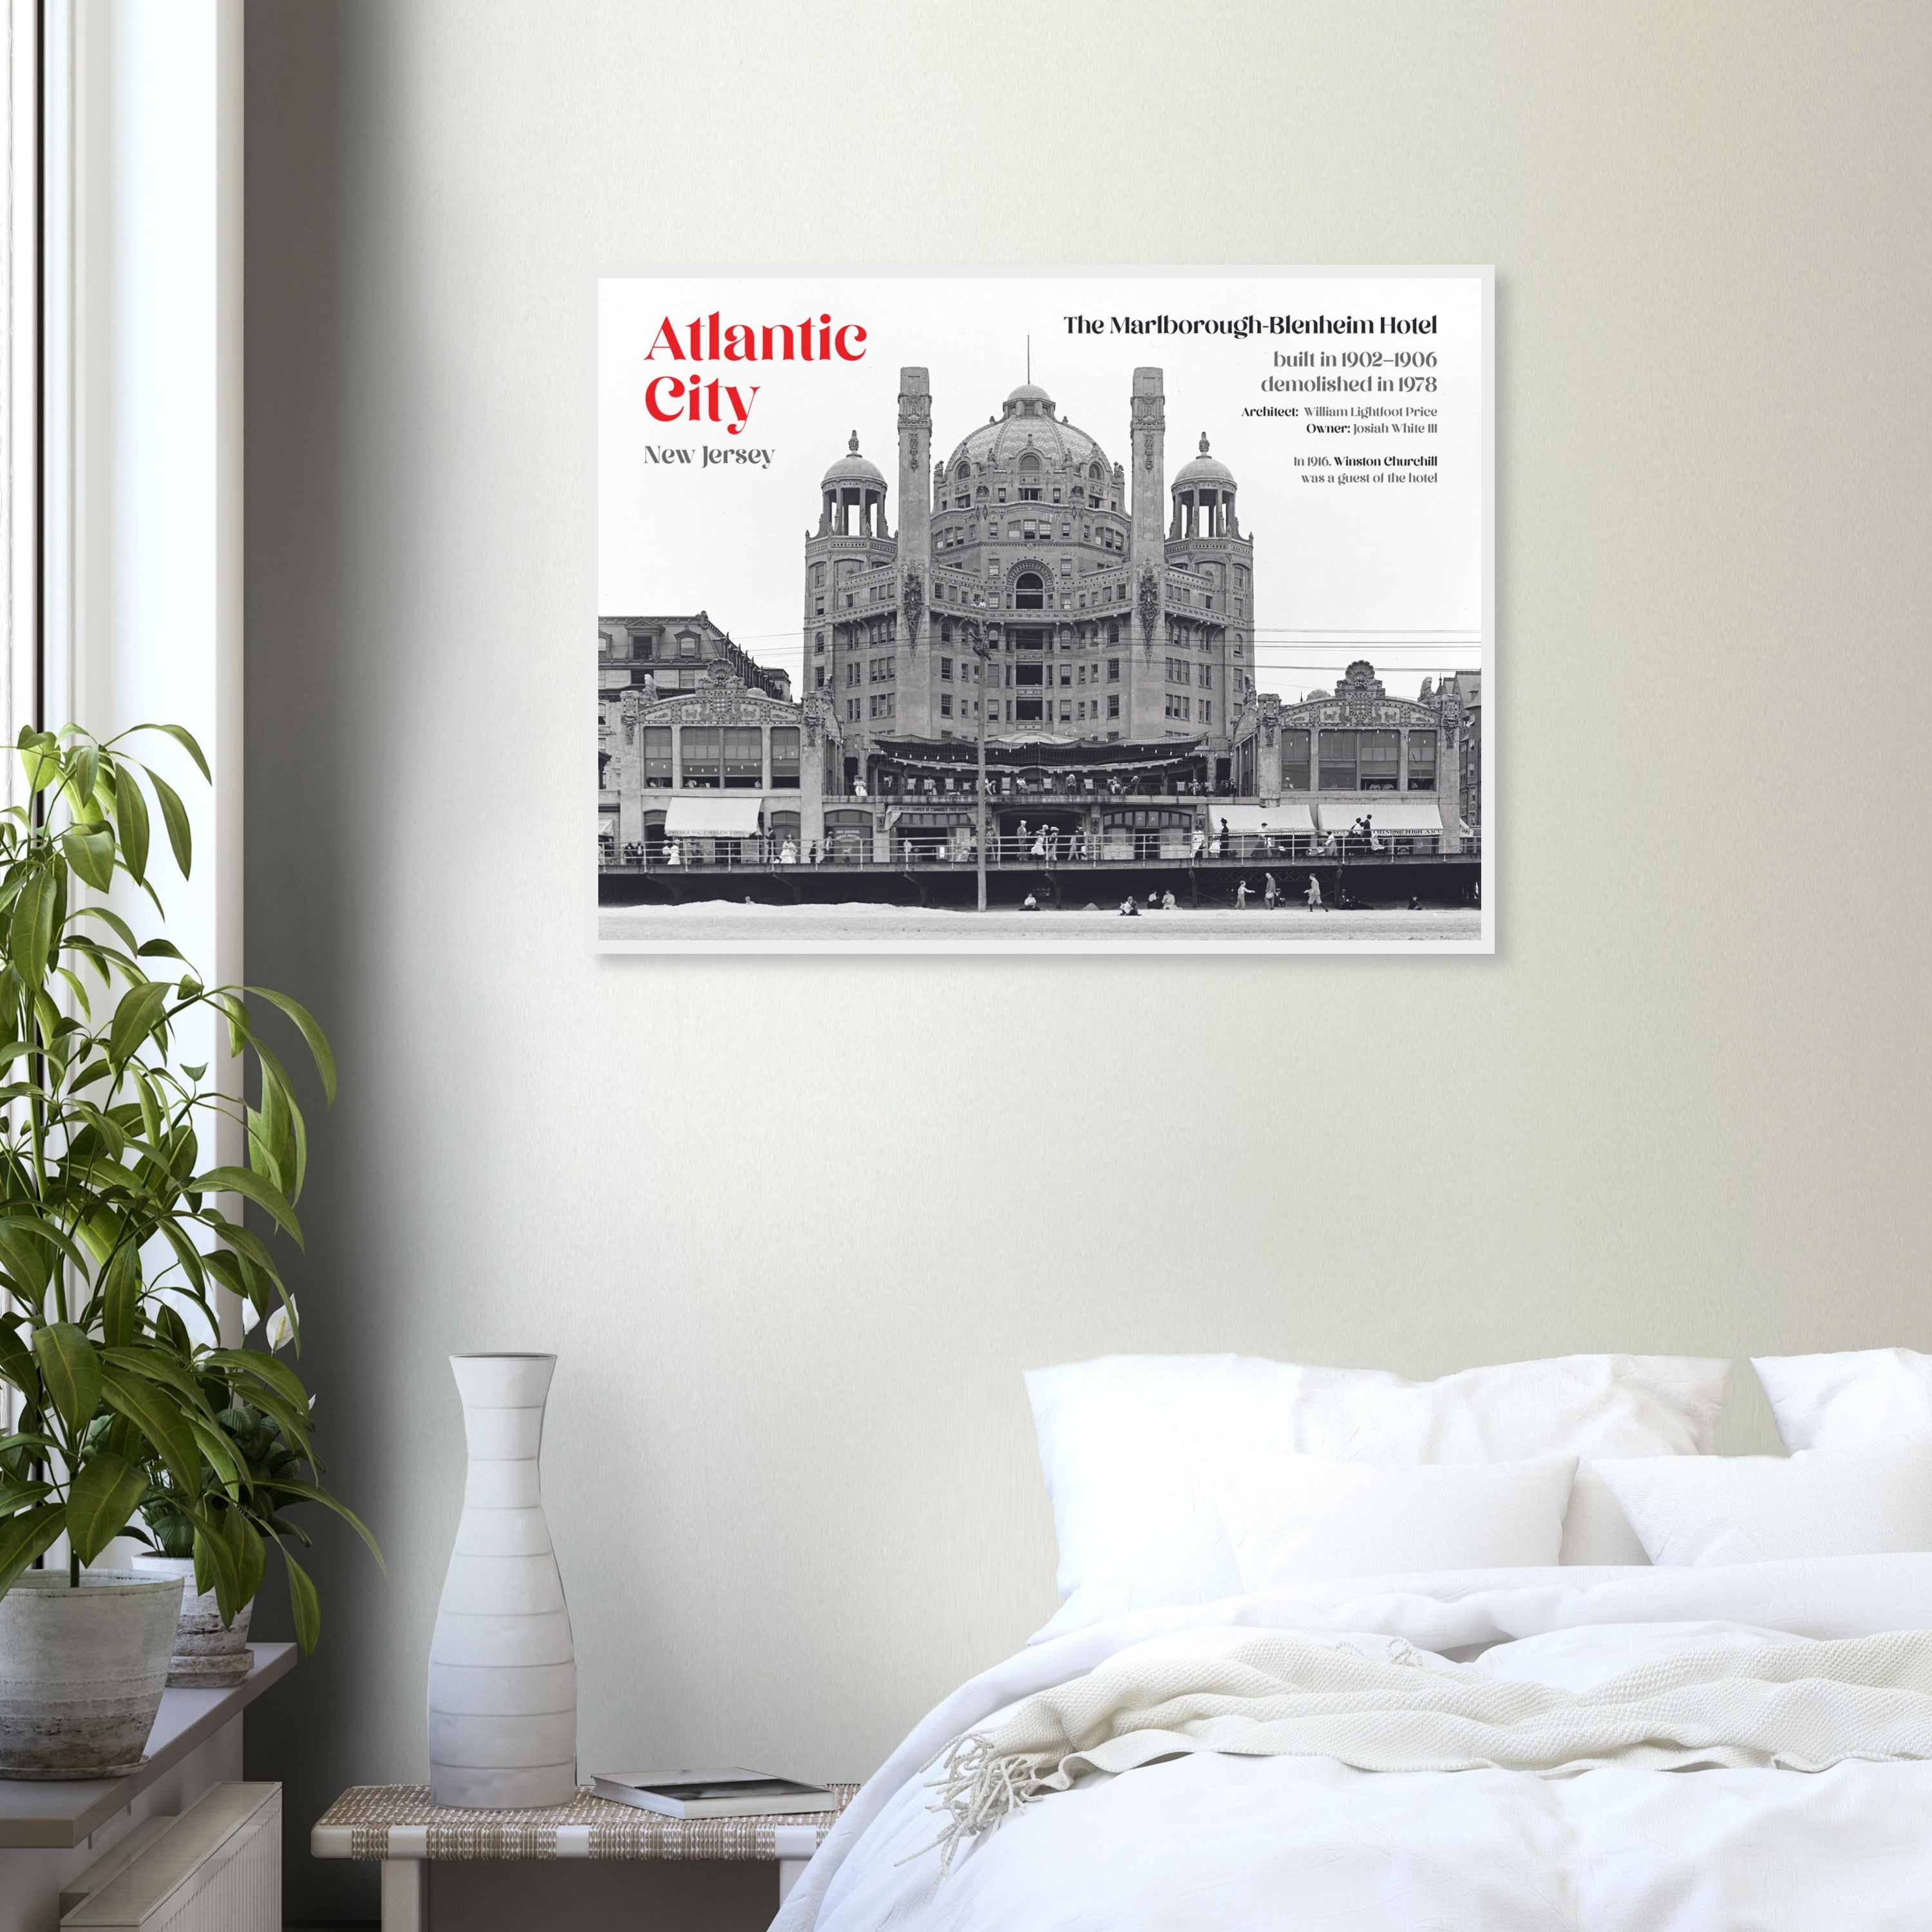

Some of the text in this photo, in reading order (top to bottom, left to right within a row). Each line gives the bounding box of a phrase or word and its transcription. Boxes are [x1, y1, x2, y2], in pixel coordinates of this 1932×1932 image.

[1064, 315, 1437, 339] The Marlborough-Blenheim Hotel
[644, 311, 867, 361] Atlantic
[1274, 351, 1315, 368] built
[1320, 352, 1337, 367] in
[1261, 376, 1437, 393] demolished in 1978
[645, 374, 761, 435] City
[1241, 406, 1438, 419] Architect: William Lightfoot Price
[1306, 422, 1437, 435] Owner: Josiah White III
[645, 446, 775, 469] New Jersey
[1294, 457, 1305, 466] In
[1333, 456, 1381, 467] Winston
[1383, 455, 1438, 467] Churchill
[1301, 472, 1437, 486] was a guest of the hotel
